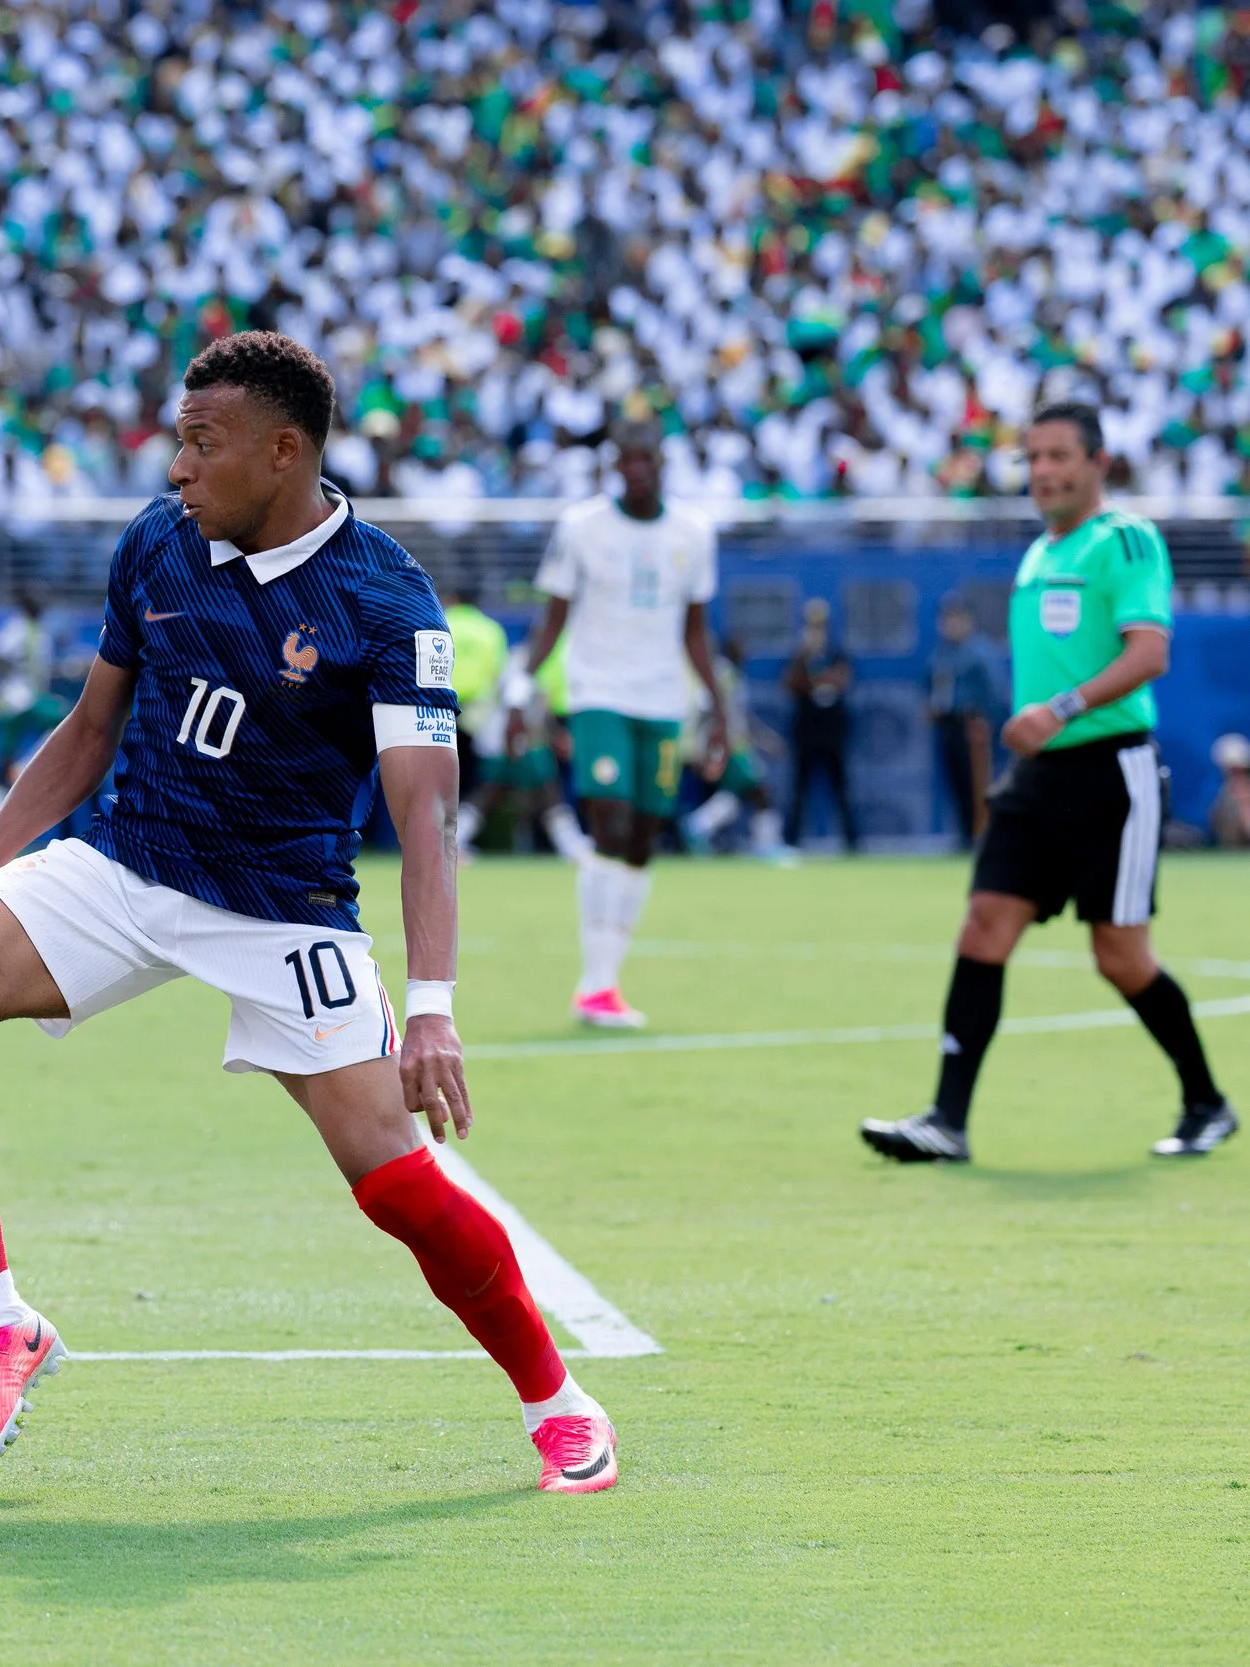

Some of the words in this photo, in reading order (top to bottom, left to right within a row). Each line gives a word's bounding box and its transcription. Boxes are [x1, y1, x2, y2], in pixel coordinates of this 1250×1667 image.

[176, 676, 247, 759] 10
[414, 720, 434, 731] the
[284, 940, 358, 1020] 10
